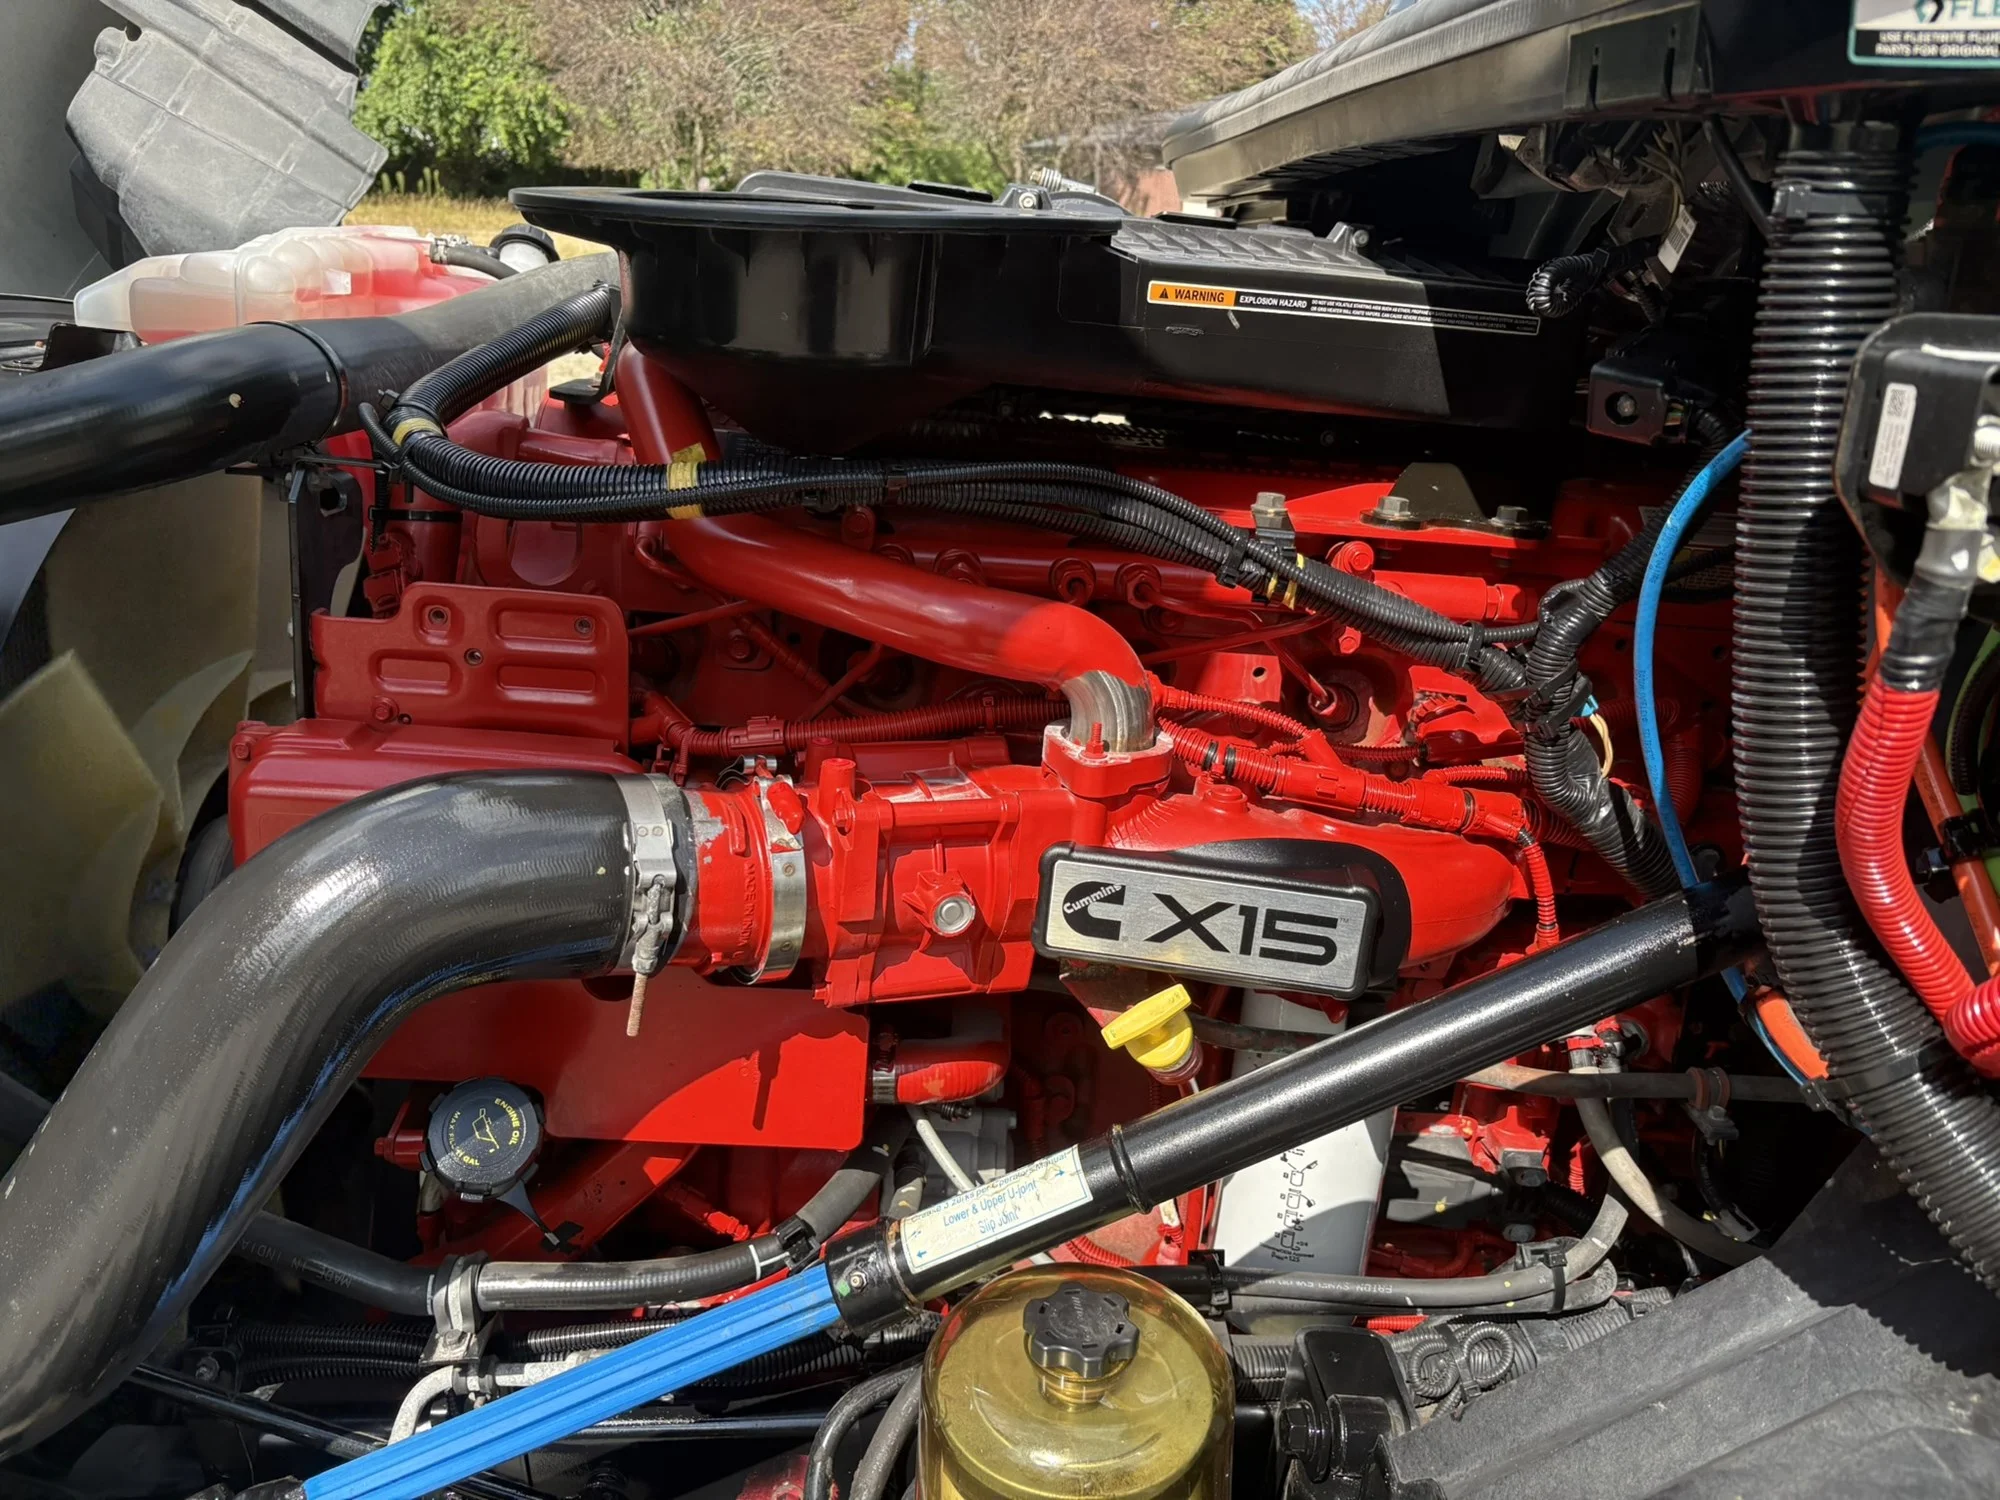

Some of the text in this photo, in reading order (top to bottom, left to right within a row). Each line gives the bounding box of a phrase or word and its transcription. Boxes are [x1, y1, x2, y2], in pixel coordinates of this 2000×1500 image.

[1939, 44, 1999, 58] ORIGINAL
[1174, 288, 1225, 303] WARNING
[1239, 295, 1308, 308] EXPLOSION HAZARD
[1063, 882, 1122, 914] Cummins
[1142, 892, 1339, 966] X15
[449, 1111, 461, 1130] MAX
[463, 1155, 480, 1166] GAL
[494, 1098, 520, 1146] ENGINE OIL
[944, 1179, 1037, 1227] Lower & Upper U-joint
[979, 1218, 996, 1234] Slip
[241, 1240, 352, 1288] MADE IN INDIA
